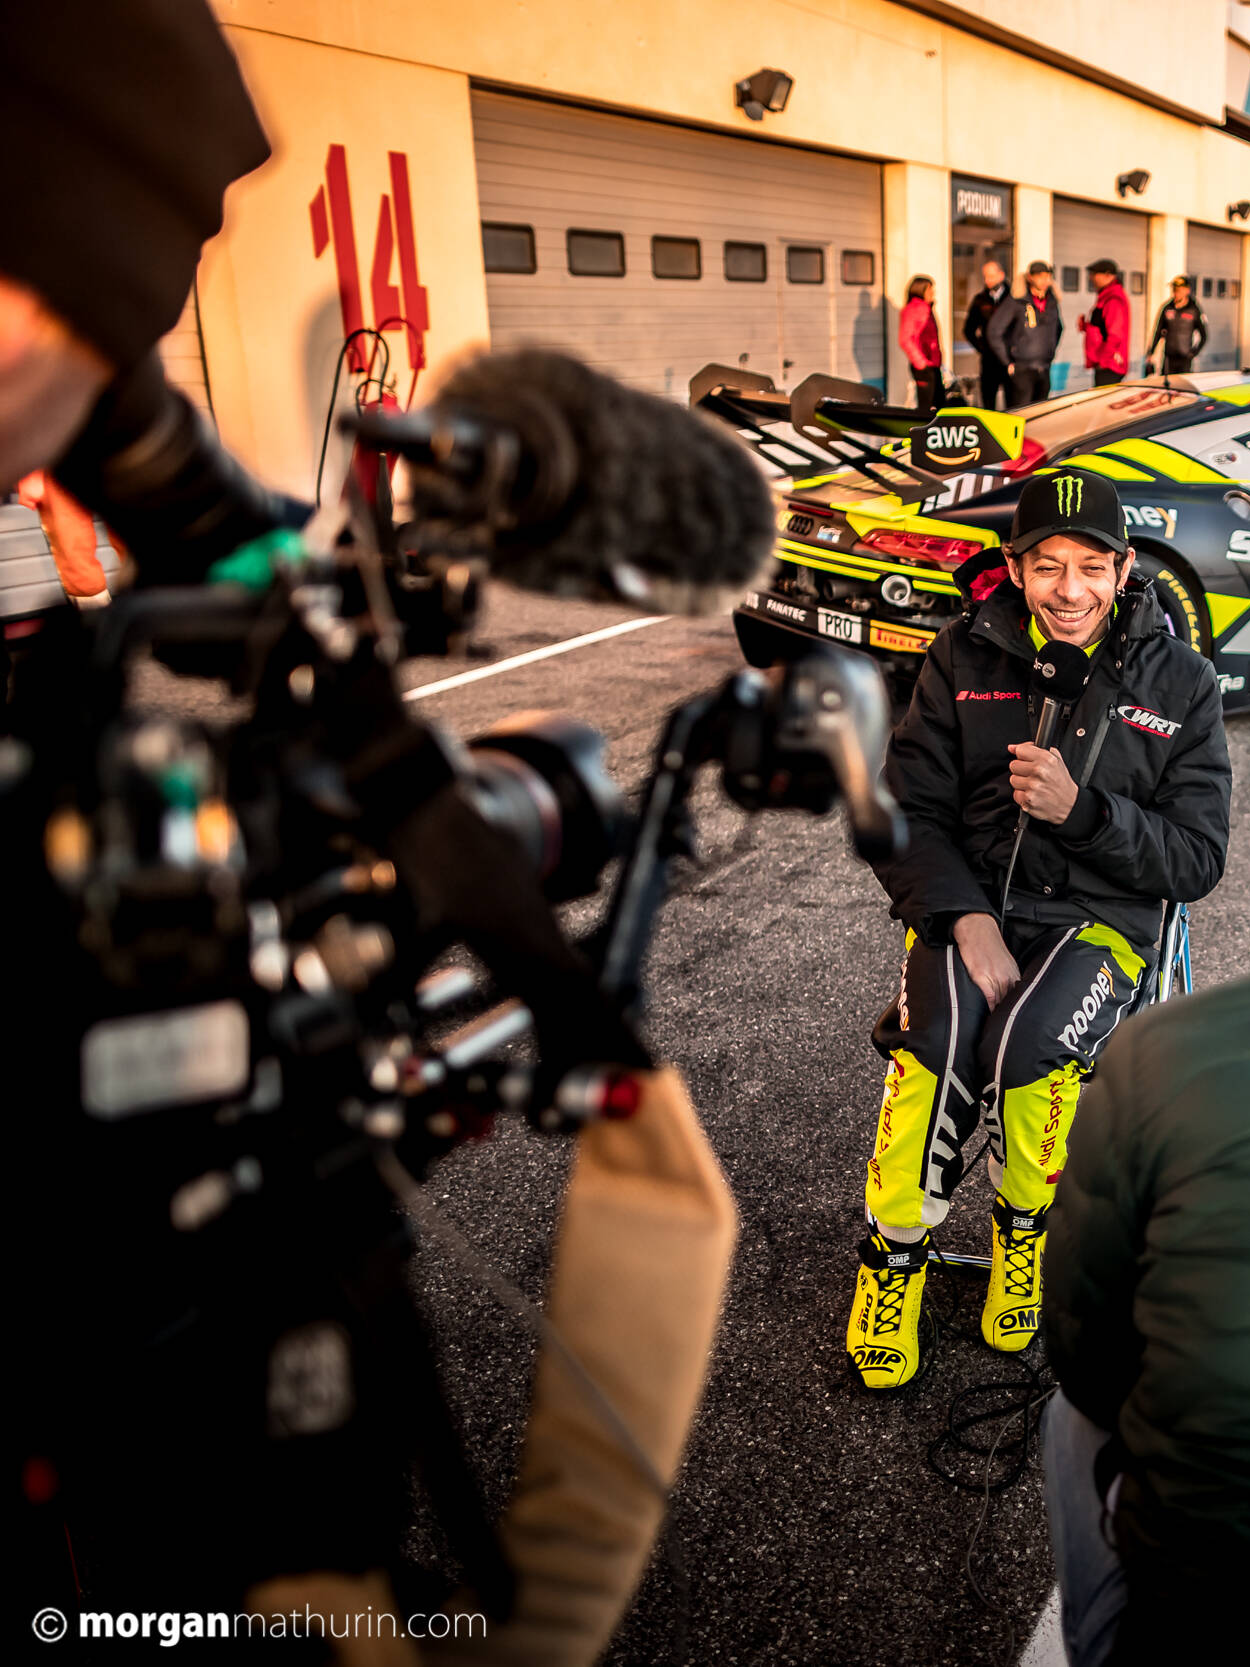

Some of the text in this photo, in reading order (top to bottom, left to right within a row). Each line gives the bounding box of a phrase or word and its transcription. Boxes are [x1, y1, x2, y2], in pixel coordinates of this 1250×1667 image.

[957, 189, 1002, 219] PODIUM
[309, 143, 430, 374] 14
[926, 425, 980, 449] aws
[1121, 505, 1178, 539] ney
[825, 613, 853, 639] PRO
[968, 690, 1021, 700] Audi Sport
[1131, 709, 1182, 735] WRT
[1012, 1217, 1035, 1227] OMP
[887, 1256, 910, 1265] OMP
[854, 1350, 902, 1367] OMP
